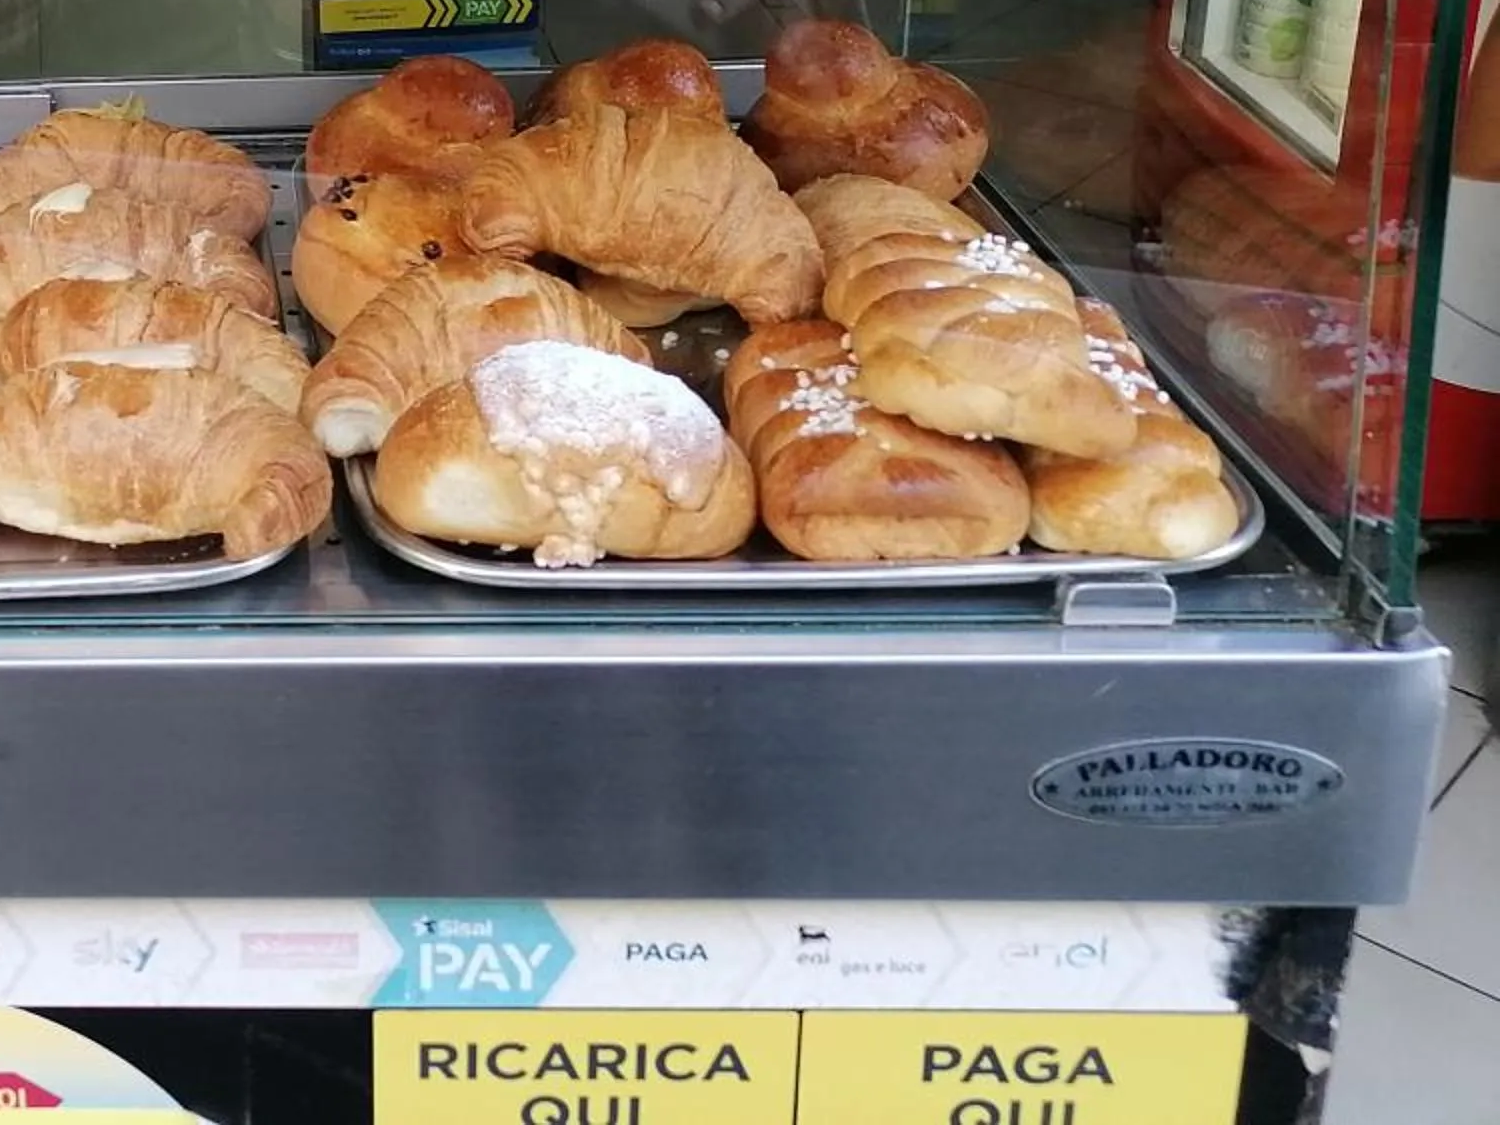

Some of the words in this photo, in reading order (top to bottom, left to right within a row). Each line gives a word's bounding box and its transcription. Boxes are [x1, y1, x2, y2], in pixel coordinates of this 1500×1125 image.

[465, 0, 501, 18] PAY
[1076, 748, 1302, 782] PALLADORO
[439, 919, 492, 937] Sisal
[419, 943, 551, 991] PAY
[626, 942, 708, 962] PAGA
[419, 1043, 751, 1082] RICARICA
[921, 1044, 1114, 1085] PAGA
[521, 1095, 640, 1125] QUI
[950, 1098, 1075, 1125] QUI
